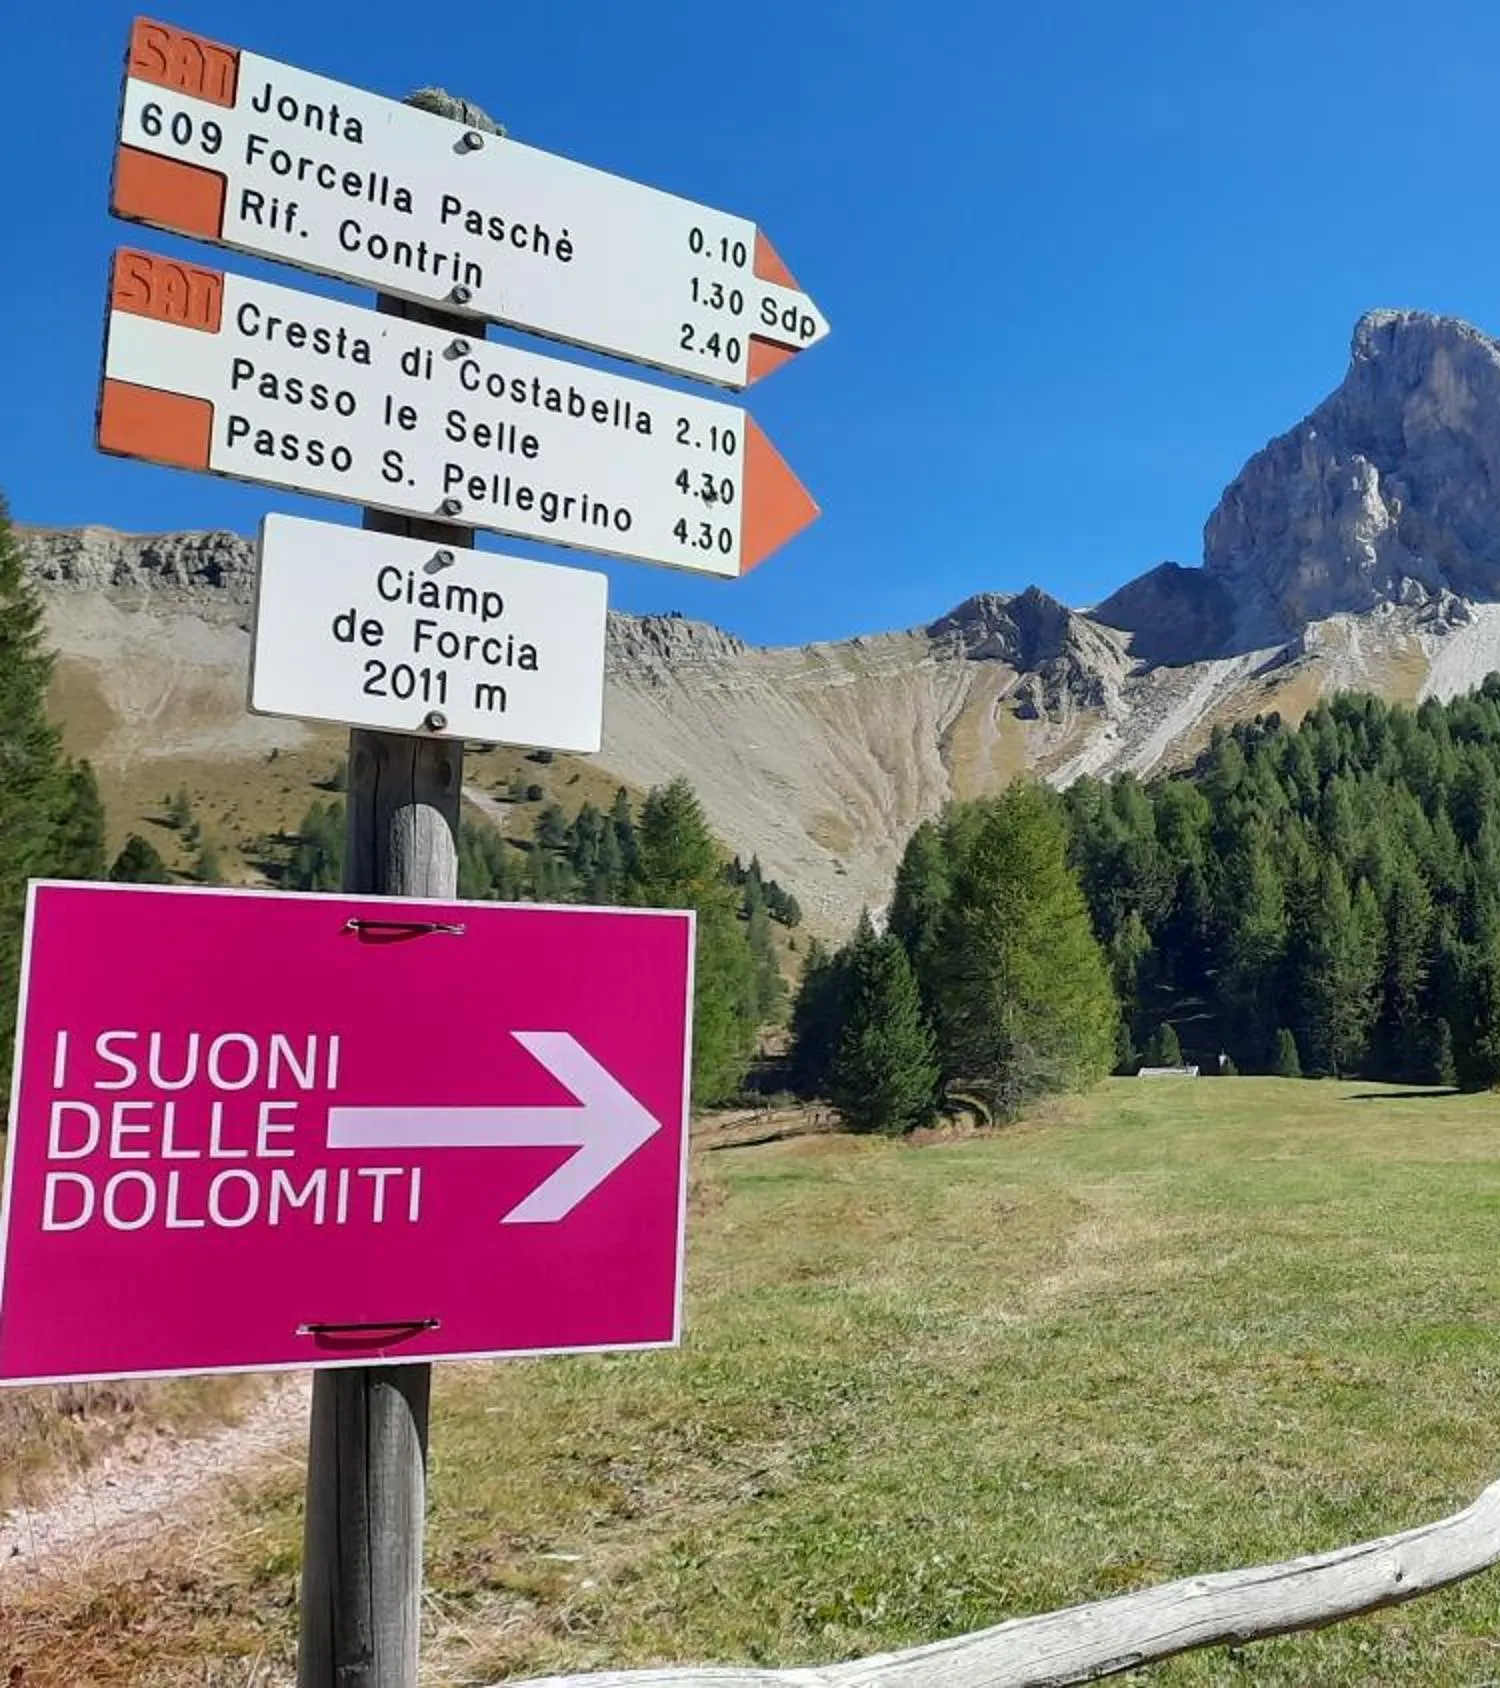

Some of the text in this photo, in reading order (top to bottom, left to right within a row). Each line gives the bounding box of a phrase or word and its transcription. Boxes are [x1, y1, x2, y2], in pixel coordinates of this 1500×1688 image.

[140, 102, 223, 155] 609
[252, 83, 747, 268] Jonta 0.10
[245, 133, 745, 316] Forcella Paschè 1.30
[240, 189, 742, 364] Rif. Contrin 2.40
[760, 298, 816, 341] Sdp
[231, 357, 357, 417] Passo
[384, 395, 418, 431] le
[445, 409, 541, 460] Selle
[236, 302, 737, 456] Cresta di Costabella 2.10
[227, 415, 733, 555] Passo S. Pellegrino 4.30
[376, 565, 505, 623] Ciamp
[331, 608, 540, 672] de Forcia
[362, 659, 508, 713] 2011 m
[52, 1030, 341, 1090] I SUONI
[46, 1100, 299, 1160] DELLE
[41, 1166, 423, 1232] DOLOMITI
